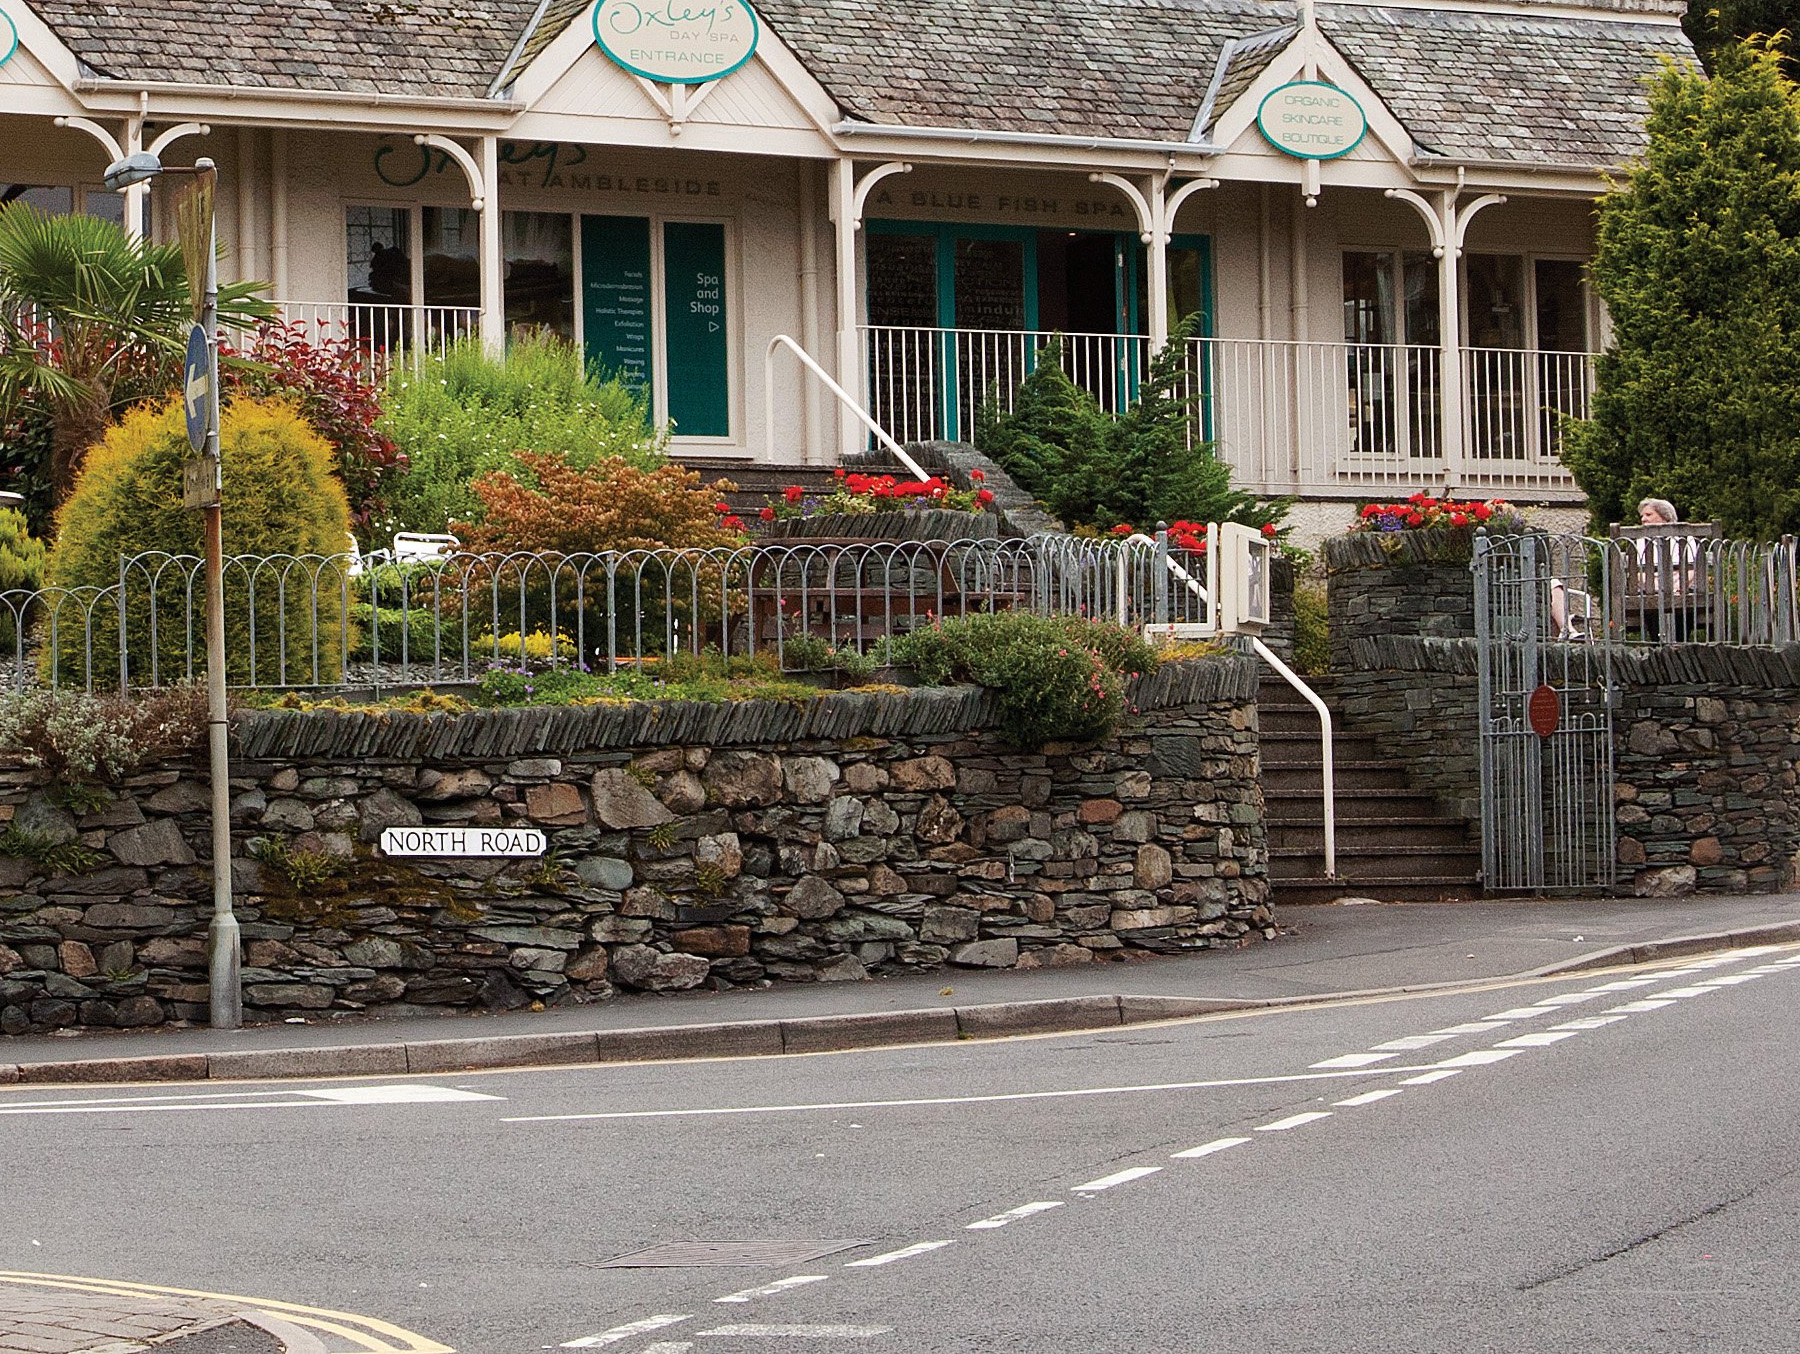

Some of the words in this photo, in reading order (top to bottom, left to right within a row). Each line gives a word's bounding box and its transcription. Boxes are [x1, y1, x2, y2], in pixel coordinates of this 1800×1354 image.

[610, 0, 734, 35] Oxley's
[670, 30, 700, 41] DAY
[709, 32, 740, 43] SPA
[630, 49, 724, 64] ENTRANCE
[1284, 95, 1340, 108] ORGANIC
[1282, 113, 1343, 126] SKINCARE
[1282, 132, 1344, 145] BOUTIQUE
[549, 172, 722, 196] AMBLESIDE
[876, 190, 893, 205] A
[911, 192, 982, 209] BLUE
[999, 197, 1058, 213] FISH
[1075, 201, 1126, 217] SPA
[697, 273, 719, 287] Spa
[697, 288, 719, 299] and
[690, 301, 720, 316] Shop
[388, 831, 466, 852] NORTH
[481, 832, 540, 853] ROAD
